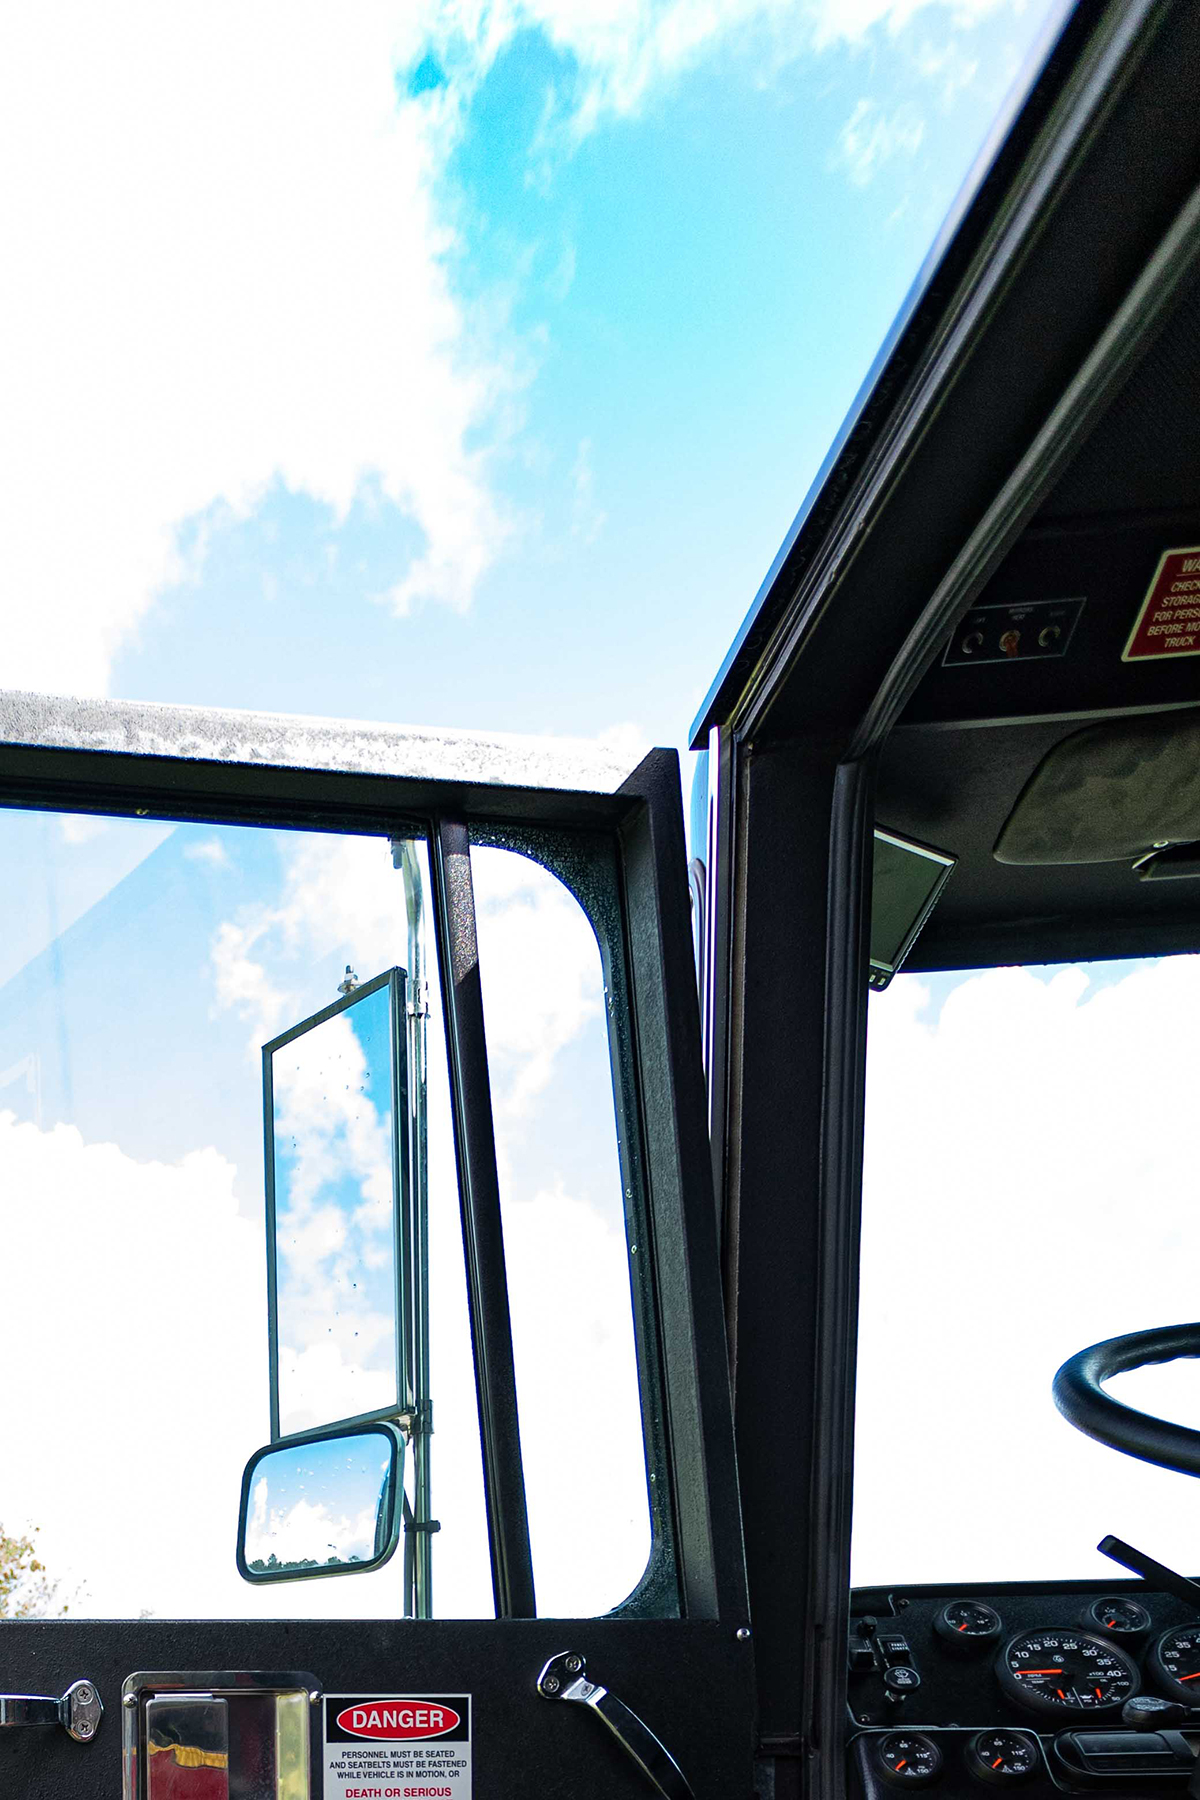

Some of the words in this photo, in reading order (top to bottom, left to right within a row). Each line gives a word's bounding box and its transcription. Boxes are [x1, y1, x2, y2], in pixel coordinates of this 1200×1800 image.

[1153, 610, 1173, 622] FOR
[1147, 623, 1186, 637] BEFORE
[1164, 635, 1197, 648] TRUCK
[1027, 1643, 1042, 1651] 15
[1175, 1641, 1191, 1649] 35
[1082, 1649, 1098, 1657] 30
[1096, 1658, 1112, 1666] 35
[352, 1709, 444, 1729] DANGER
[341, 1751, 389, 1759] PERSONNEL
[390, 1750, 412, 1758] MUST
[413, 1750, 424, 1758] BE
[425, 1750, 455, 1758] SEATED
[329, 1761, 347, 1769] AND
[347, 1761, 392, 1769] SEATBELTS
[393, 1760, 414, 1769] MUST
[415, 1760, 427, 1768] BE
[428, 1760, 467, 1768] FASTENED
[336, 1771, 362, 1779] WHILE
[362, 1771, 395, 1779] VEHICLE
[396, 1771, 405, 1779] IS
[406, 1770, 414, 1779] IN
[415, 1770, 447, 1779] MOTION,
[448, 1770, 460, 1778] OR
[345, 1788, 382, 1799] DEATH
[384, 1788, 401, 1798] OR
[403, 1787, 452, 1797] SERIOUS
